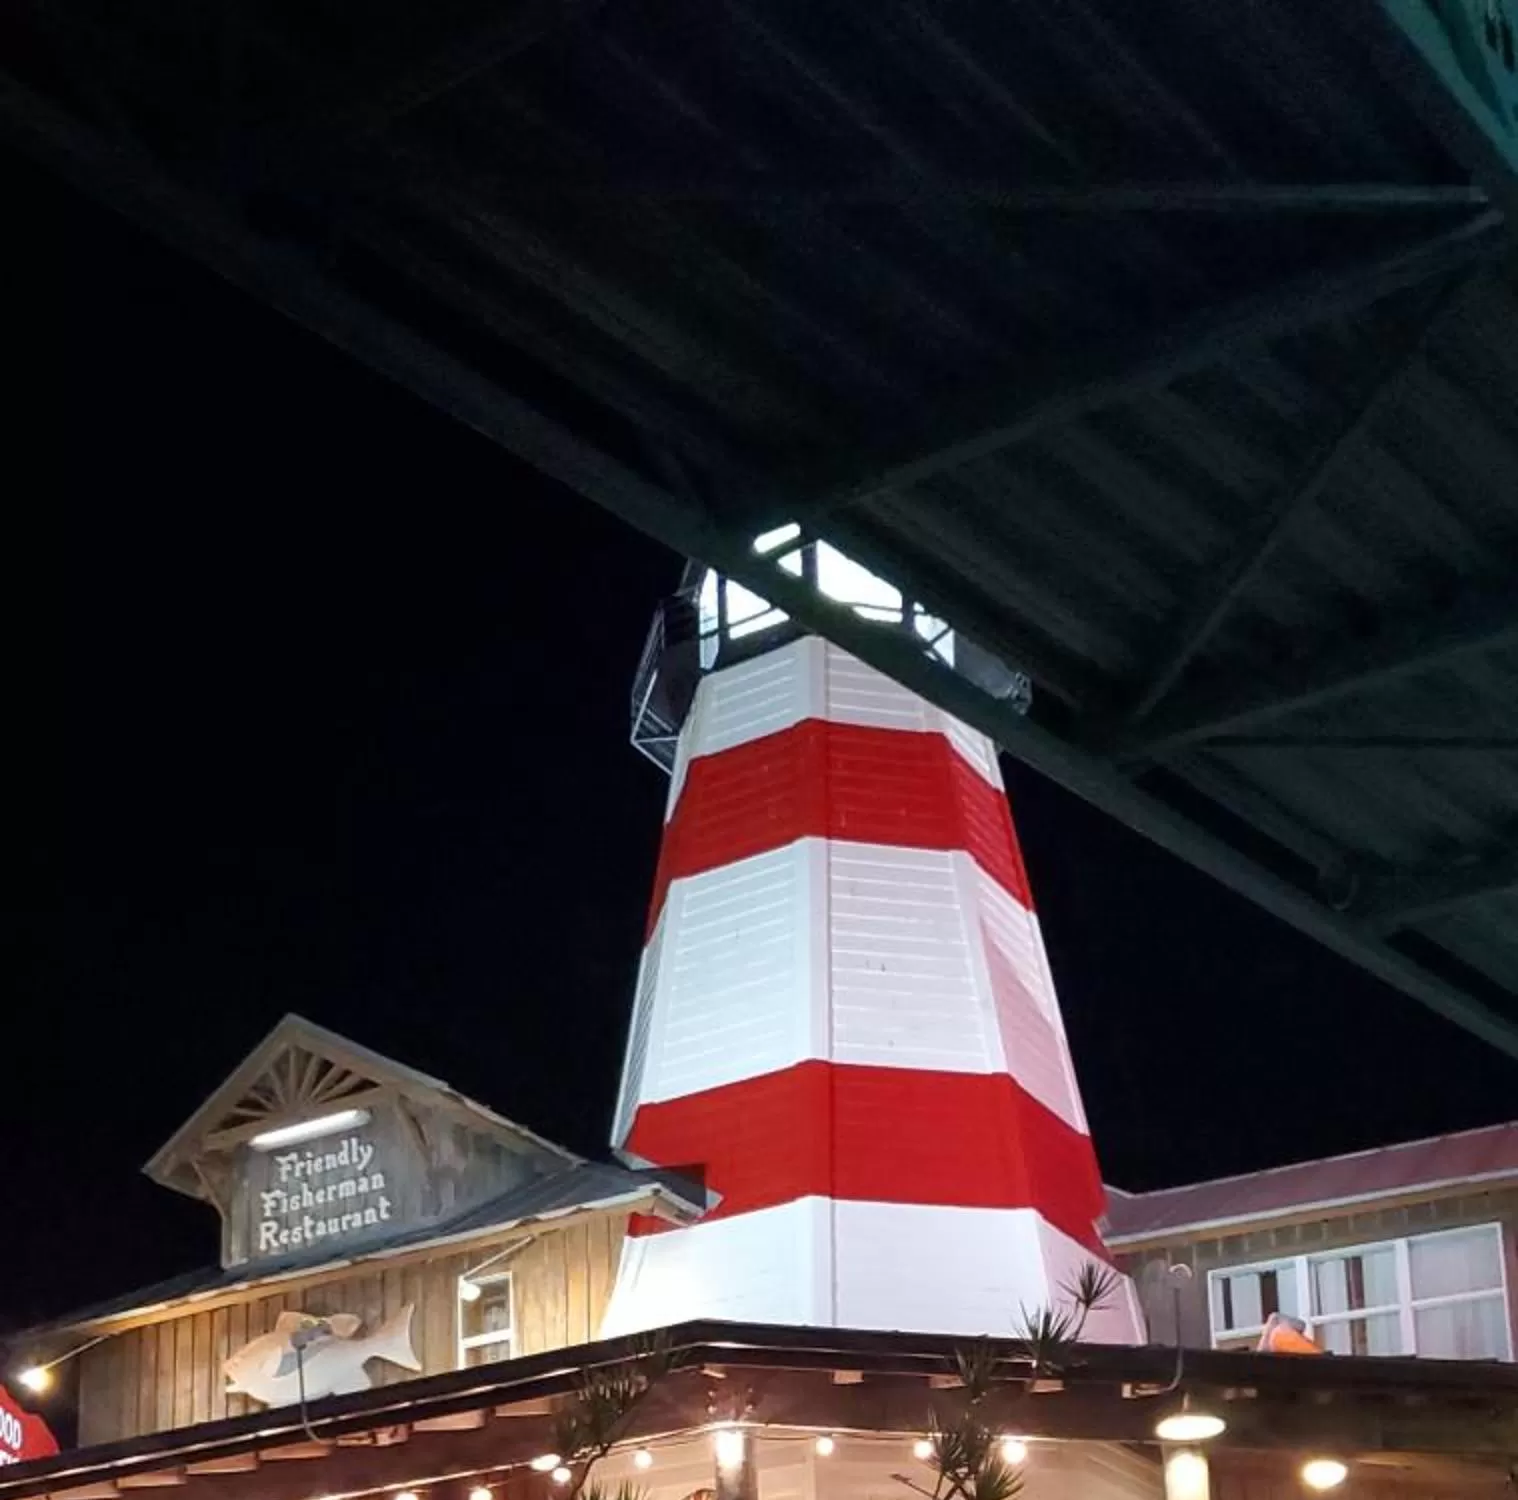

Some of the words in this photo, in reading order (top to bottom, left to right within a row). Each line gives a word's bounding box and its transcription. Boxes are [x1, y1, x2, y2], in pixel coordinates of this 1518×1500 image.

[276, 1138, 372, 1181] Friendly
[261, 1173, 385, 1216] Fisherman
[260, 1196, 391, 1250] Restaurant
